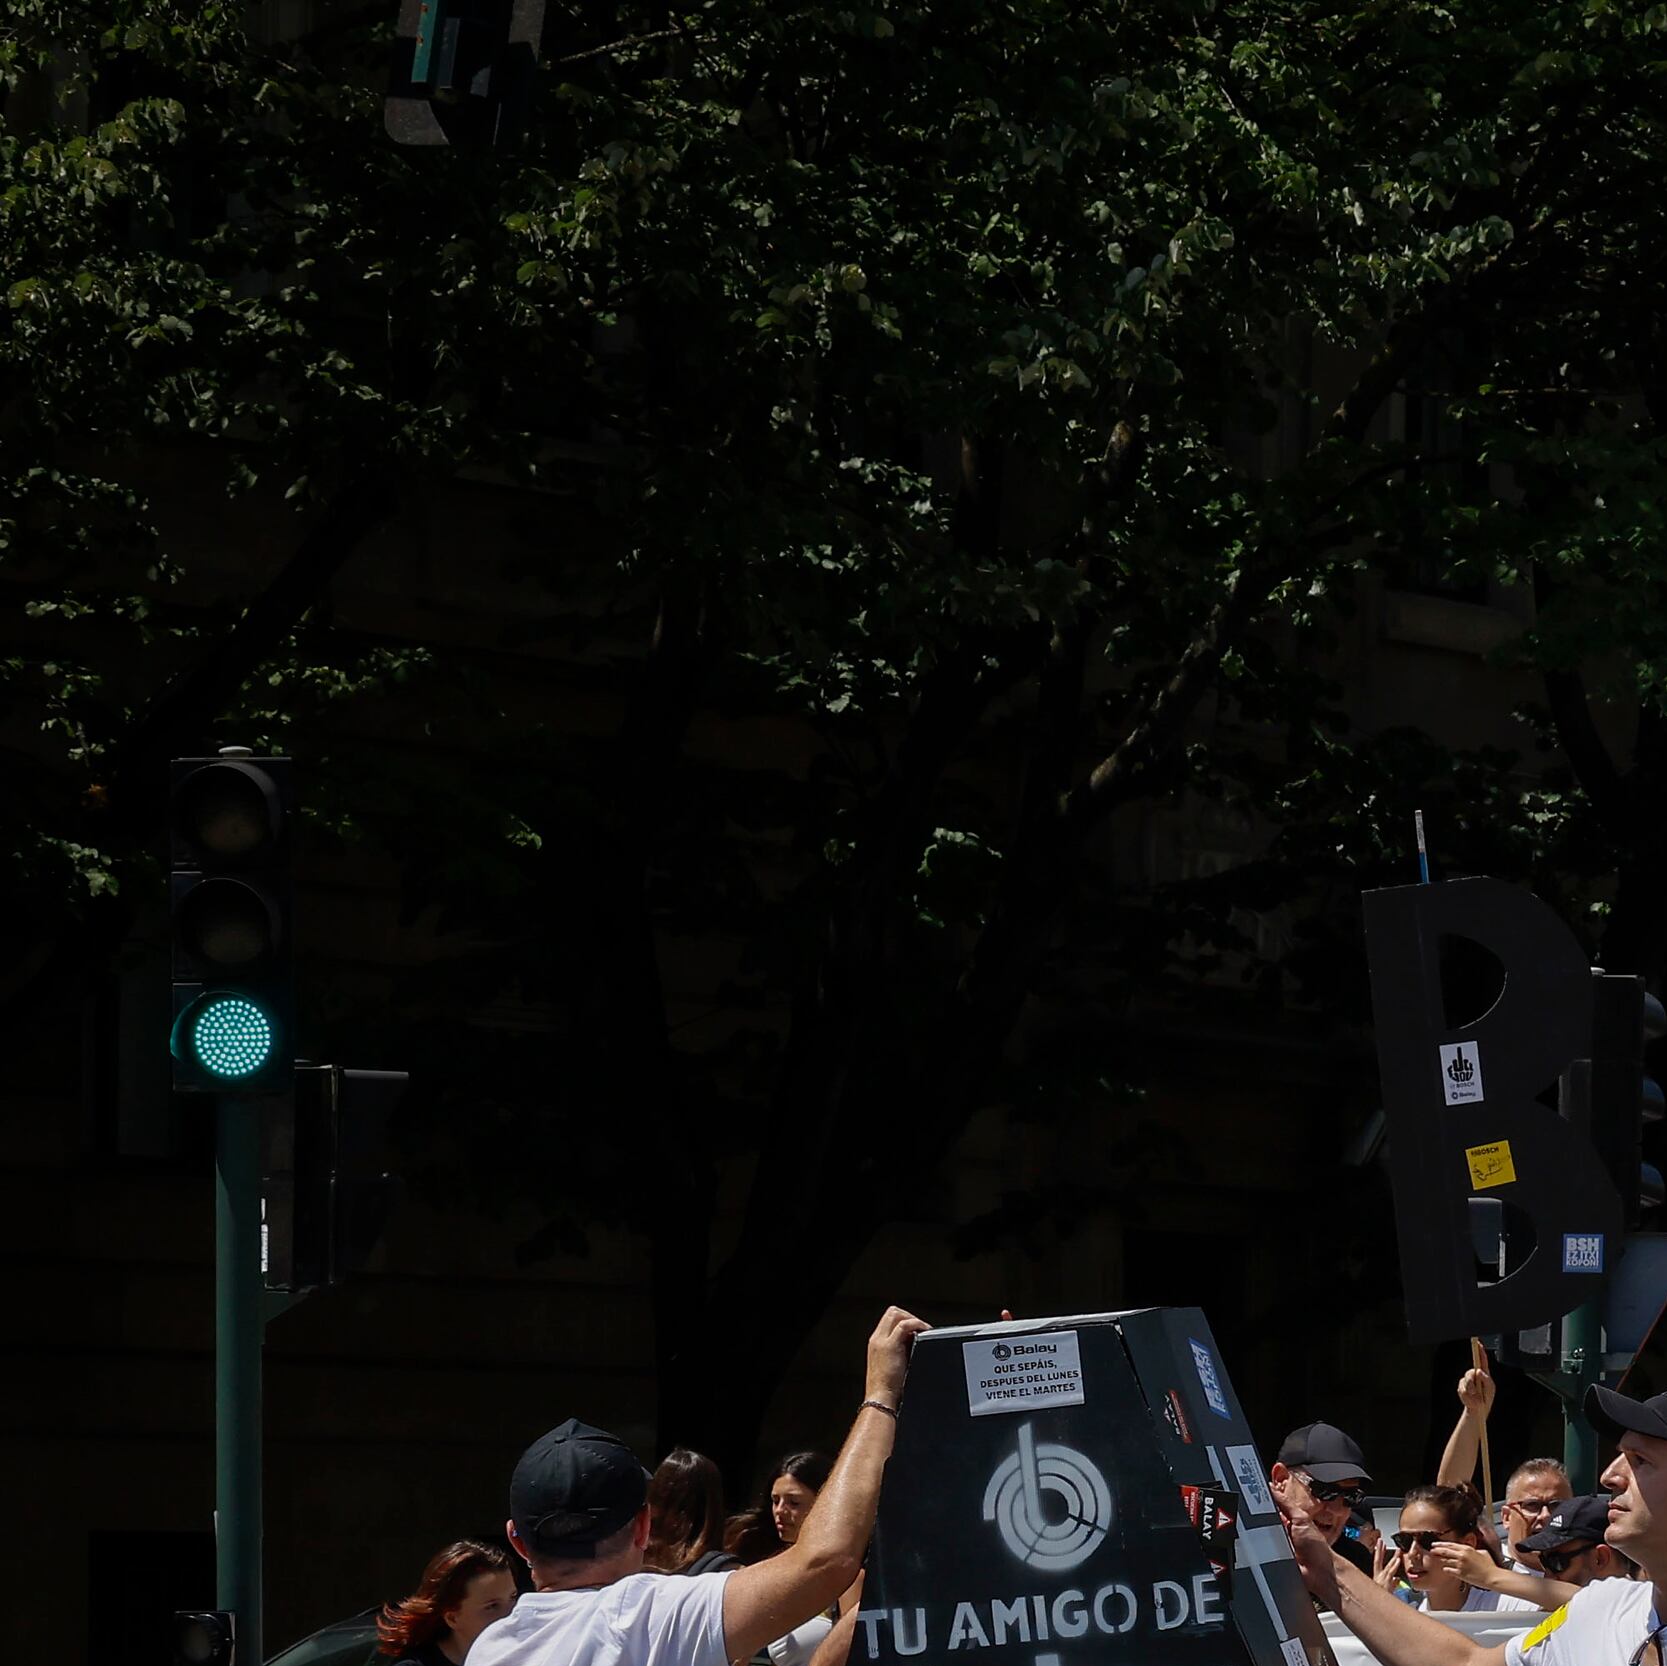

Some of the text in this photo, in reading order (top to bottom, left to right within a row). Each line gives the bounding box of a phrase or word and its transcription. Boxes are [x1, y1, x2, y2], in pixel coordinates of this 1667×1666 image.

[1566, 1237, 1599, 1251] BSH
[1013, 1343, 1057, 1356] Balay
[994, 1359, 1057, 1374] QUE SEPÁIS,
[980, 1369, 1079, 1388] DESPUES DEL LUNES
[986, 1382, 1076, 1400] VIENE EL MARTES
[1201, 1496, 1215, 1541] BALAY
[858, 1573, 1228, 1659] TU AMIGO DE
